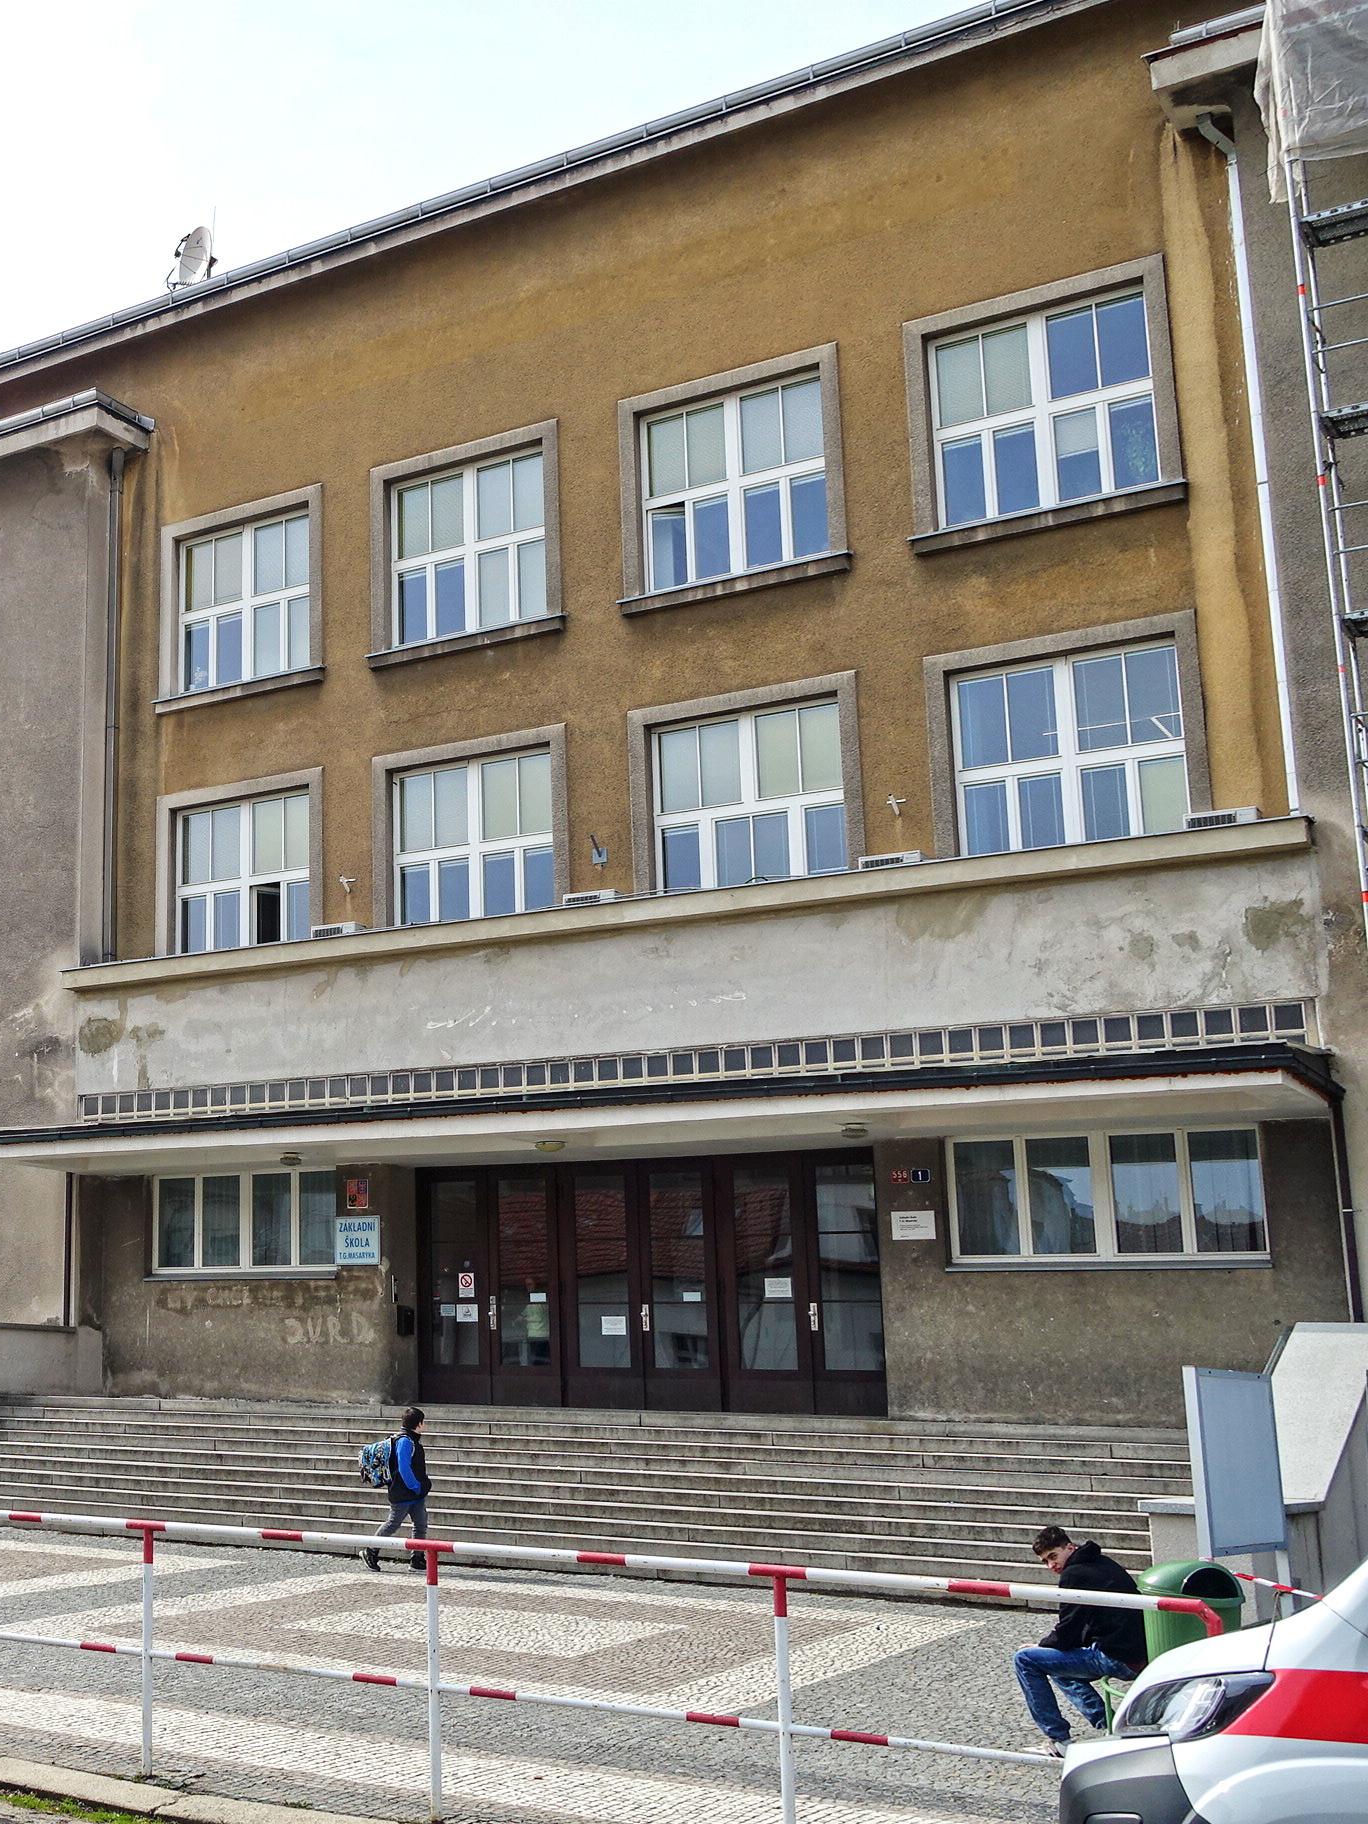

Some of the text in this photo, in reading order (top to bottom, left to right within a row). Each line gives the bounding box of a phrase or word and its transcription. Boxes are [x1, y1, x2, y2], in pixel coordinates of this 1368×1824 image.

[892, 1170, 908, 1179] 556
[918, 1170, 922, 1181] 1
[339, 1219, 376, 1232] ZÁKLADNÍ
[344, 1235, 370, 1248] ŠKOLA
